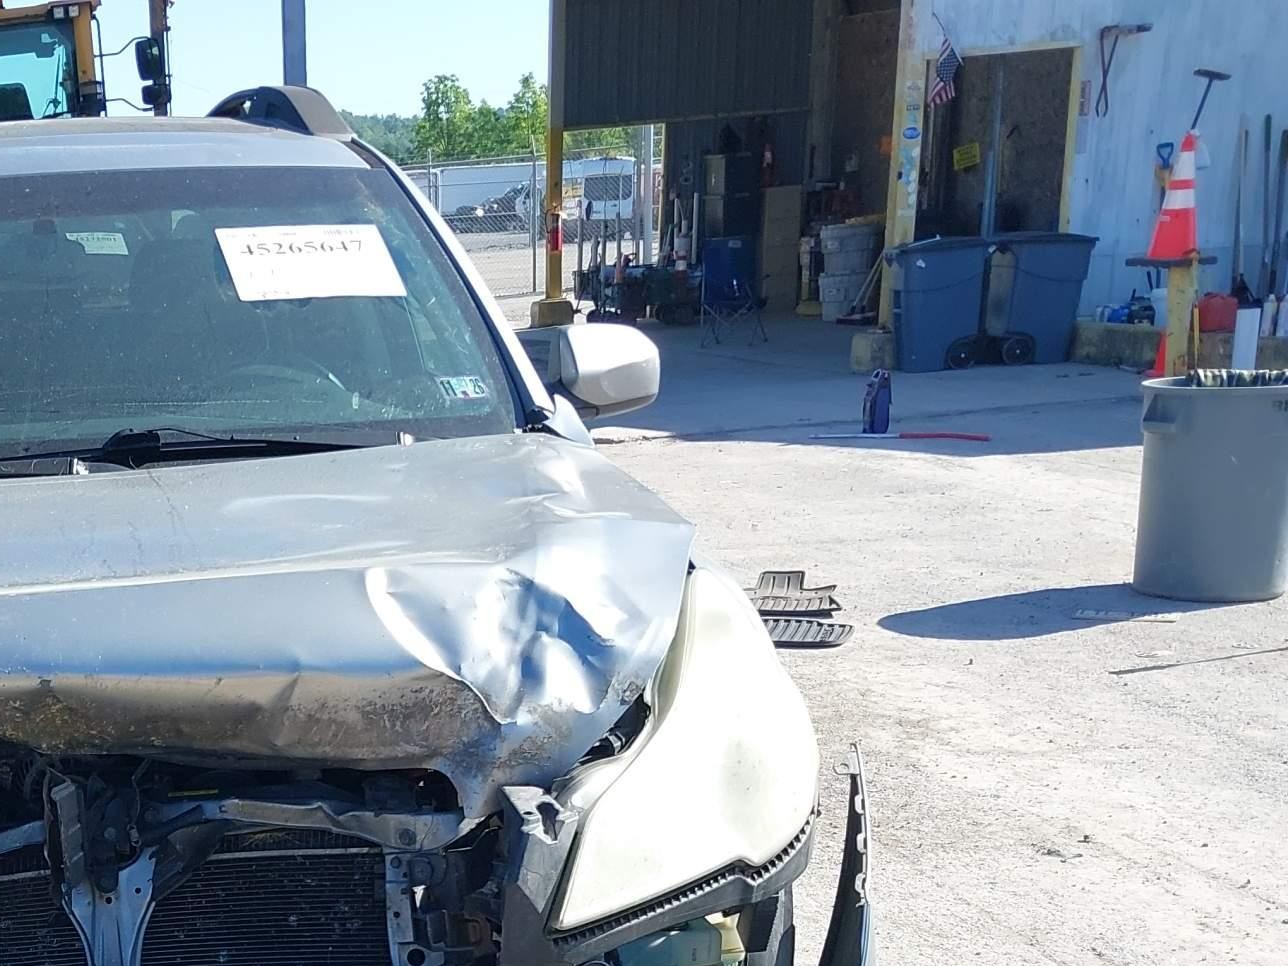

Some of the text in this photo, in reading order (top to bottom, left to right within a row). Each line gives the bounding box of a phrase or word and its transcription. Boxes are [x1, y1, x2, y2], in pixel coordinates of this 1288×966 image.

[240, 239, 362, 256] 45265647
[440, 378, 485, 397] 11 26
